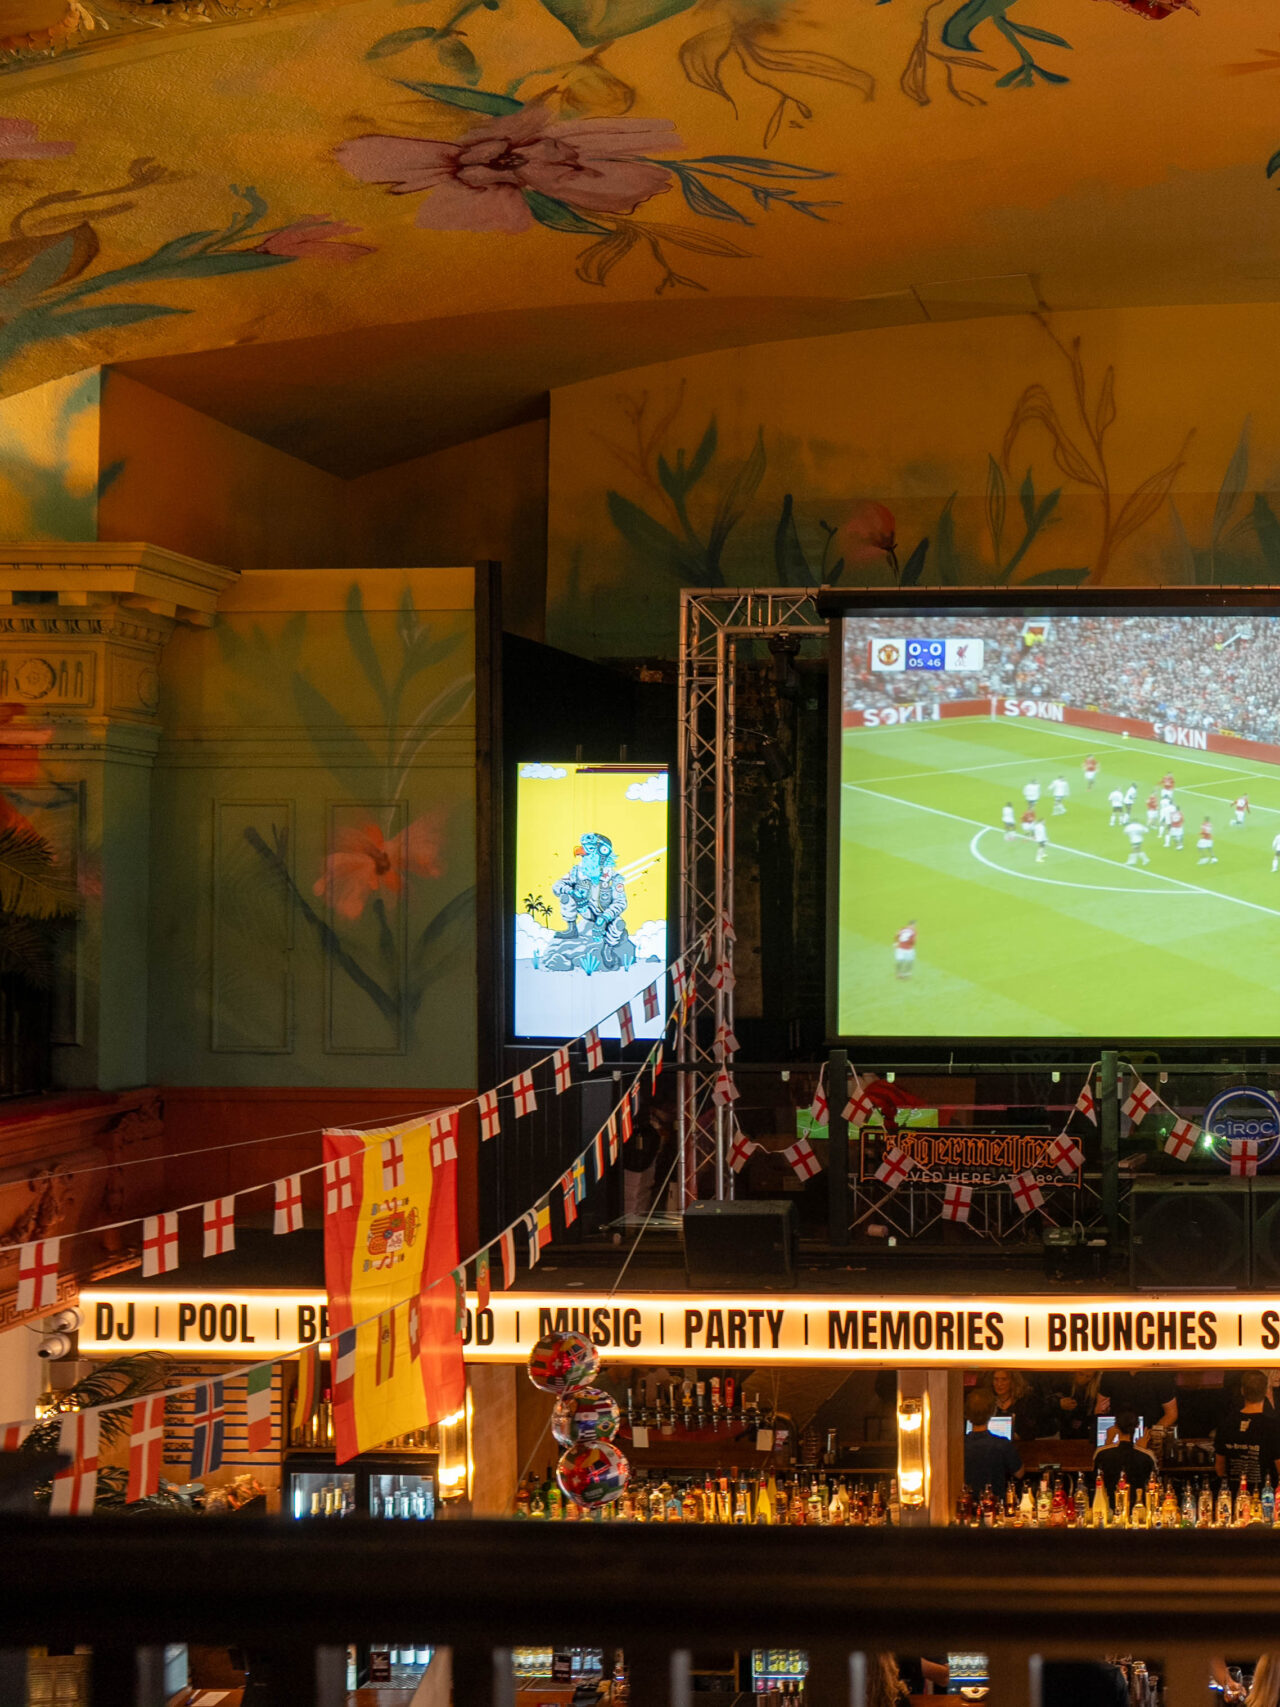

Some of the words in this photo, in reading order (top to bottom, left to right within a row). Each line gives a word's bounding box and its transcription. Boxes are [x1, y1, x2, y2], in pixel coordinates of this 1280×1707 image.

[908, 643, 942, 656] 0-0
[1004, 700, 1064, 722] SOKIN
[949, 1172, 992, 1184] HERE
[96, 1302, 134, 1341] DJ
[179, 1303, 255, 1343] POOL
[539, 1307, 642, 1347] MUSIC
[684, 1309, 785, 1349] PARTY
[828, 1310, 1004, 1352] MEMORIES
[1047, 1311, 1217, 1353] BRUNCHES
